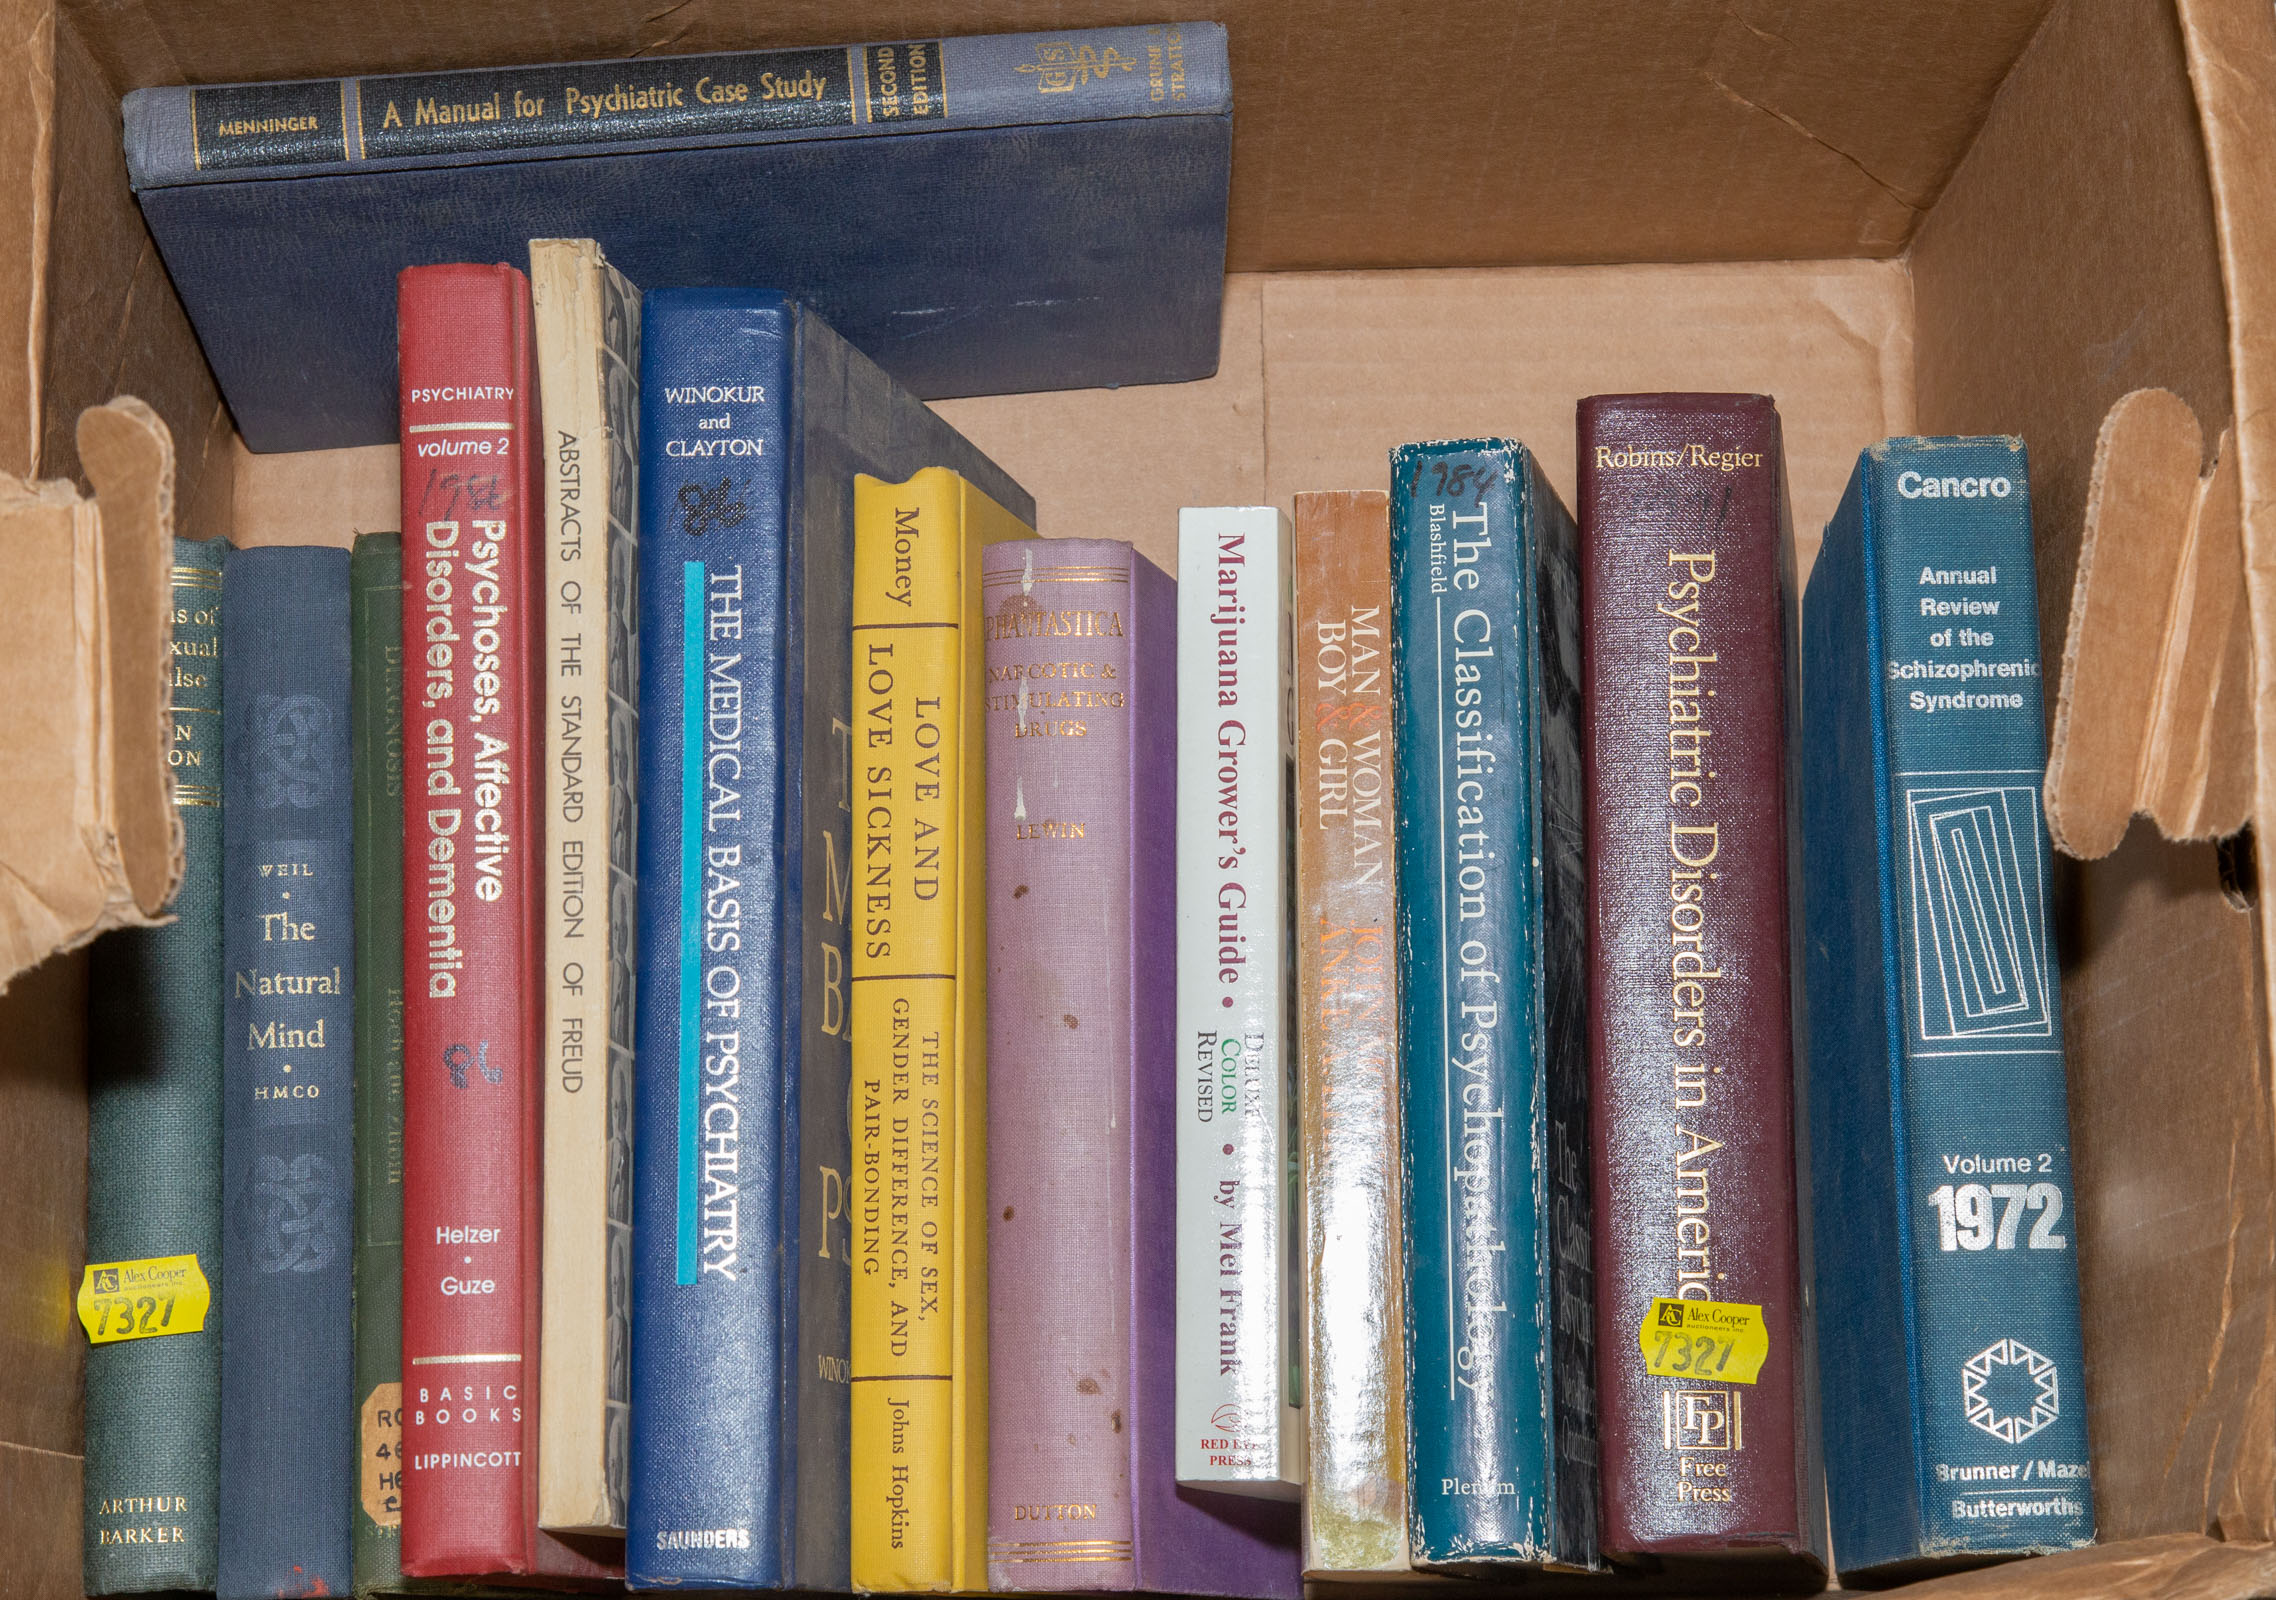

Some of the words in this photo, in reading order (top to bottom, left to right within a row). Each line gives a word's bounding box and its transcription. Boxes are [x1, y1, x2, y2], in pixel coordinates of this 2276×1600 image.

[383, 102, 403, 128] A
[416, 92, 500, 127] Manual
[515, 88, 544, 119] for
[566, 80, 683, 118] Psychiatric
[695, 76, 749, 105] Case
[762, 71, 827, 102] Study
[882, 47, 900, 117] SECOND
[910, 43, 927, 116] EDITION
[218, 115, 319, 138] MENNINGER
[411, 386, 514, 403] PSYCHIATRY
[665, 386, 766, 404] WINOKUR
[699, 413, 731, 429] and
[417, 439, 492, 457] volume
[498, 437, 510, 455] 2
[665, 439, 764, 457] CLAYTON
[1595, 444, 1764, 472] Robins/Regier
[558, 430, 582, 562] ABSTRACTS
[1410, 461, 1498, 508] 1984
[1897, 471, 2012, 499] Cancro
[885, 507, 920, 607] Money
[1429, 504, 1447, 594] Blashfield
[1452, 501, 1493, 591] The
[560, 581, 582, 614] OF
[1919, 566, 1997, 585] Annual
[422, 521, 461, 708] Disorders,
[465, 520, 508, 723] Psychoses,
[709, 564, 742, 641] THE
[984, 610, 1125, 641] PHANTASTICA
[1210, 533, 1246, 708] Marijuana
[1920, 597, 2001, 616] Review
[561, 633, 582, 677] THE
[1317, 619, 1347, 696] BOY
[1351, 604, 1381, 696] MAN
[1930, 628, 1953, 647] of
[1959, 627, 1995, 647] the
[988, 662, 1096, 684] NARCOTIC
[1101, 663, 1117, 680] &
[1658, 550, 1718, 807] Psychiatric
[1889, 658, 2041, 682] Schizophrenic
[868, 643, 894, 748] LOVE
[1909, 690, 2024, 713] Syndrome
[708, 653, 742, 832] MEDICAL
[914, 696, 941, 802] LOVE
[1014, 719, 1088, 739] DRUGS
[427, 718, 461, 796] and
[561, 695, 584, 823] STANDARD
[1453, 609, 1497, 922] Classification
[1217, 719, 1246, 870] Grower's
[1318, 738, 1348, 830] GIRL
[473, 732, 510, 902] Affective
[1016, 822, 1086, 841] LEWIN
[1352, 729, 1384, 888] WOMAN
[258, 863, 314, 878] WEIL
[866, 766, 893, 959] SICKNESS
[914, 817, 940, 901] AND
[428, 808, 463, 998] Dementia
[562, 840, 584, 938] EDITION
[706, 845, 741, 953] BASIS
[257, 911, 316, 942] The
[1218, 882, 1247, 984] Guide
[1670, 822, 1721, 1048] Disorders
[234, 966, 342, 999] Natural
[562, 962, 584, 997] OF
[1459, 940, 1500, 984] of
[706, 966, 741, 1019] OF
[247, 1018, 326, 1051] Mind
[561, 1018, 583, 1093] FREUD
[892, 998, 910, 1103] GENDER
[922, 1031, 939, 1086] THE
[1197, 1031, 1217, 1123] REVISED
[1221, 1038, 1242, 1114] COLOR
[254, 1084, 320, 1100] HMCO
[1675, 1063, 1722, 1110] in
[703, 1032, 740, 1281] PSYCHIATRY
[921, 1098, 939, 1208] SCIENCE
[1943, 1154, 2032, 1175] Volume
[2038, 1153, 2053, 1173] 2
[863, 1080, 880, 1276] PAIR-BONDING
[1213, 1180, 1240, 1210] by
[1451, 1001, 1507, 1401] Psychopathology
[888, 1117, 909, 1288] DIFFERENCE,
[1675, 1124, 1725, 1301] Americ
[1929, 1182, 2067, 1251] 1972
[436, 1226, 501, 1244] Helzer
[921, 1220, 938, 1255] OF
[123, 1268, 146, 1284] Alex
[148, 1265, 187, 1281] Cooper
[440, 1276, 496, 1295] Guze
[918, 1266, 938, 1321] SEX,
[94, 1293, 177, 1336] 7327
[891, 1300, 908, 1357] AND
[1219, 1289, 1243, 1377] Frank
[1687, 1307, 1710, 1322] Alex
[1712, 1309, 1750, 1328] Cooper
[1654, 1330, 1736, 1376] 7327
[416, 1407, 521, 1425] BOOKS
[420, 1385, 517, 1402] BASIC
[887, 1397, 909, 1455] Johns
[1201, 1438, 1229, 1450] RED
[414, 1452, 521, 1470] LIPPINCOTT
[1679, 1456, 1727, 1477] Free
[1935, 1462, 2021, 1483] Brunner
[99, 1496, 188, 1515] ARTHUR
[886, 1465, 909, 1550] Hopkins
[1441, 1478, 1516, 1496] Plenm
[1677, 1481, 1731, 1502] Press
[1951, 1495, 2084, 1521] Butterworths
[1013, 1503, 1097, 1521] DUTTON
[100, 1527, 185, 1545] BARKER
[656, 1529, 749, 1550] SAUNDERS
